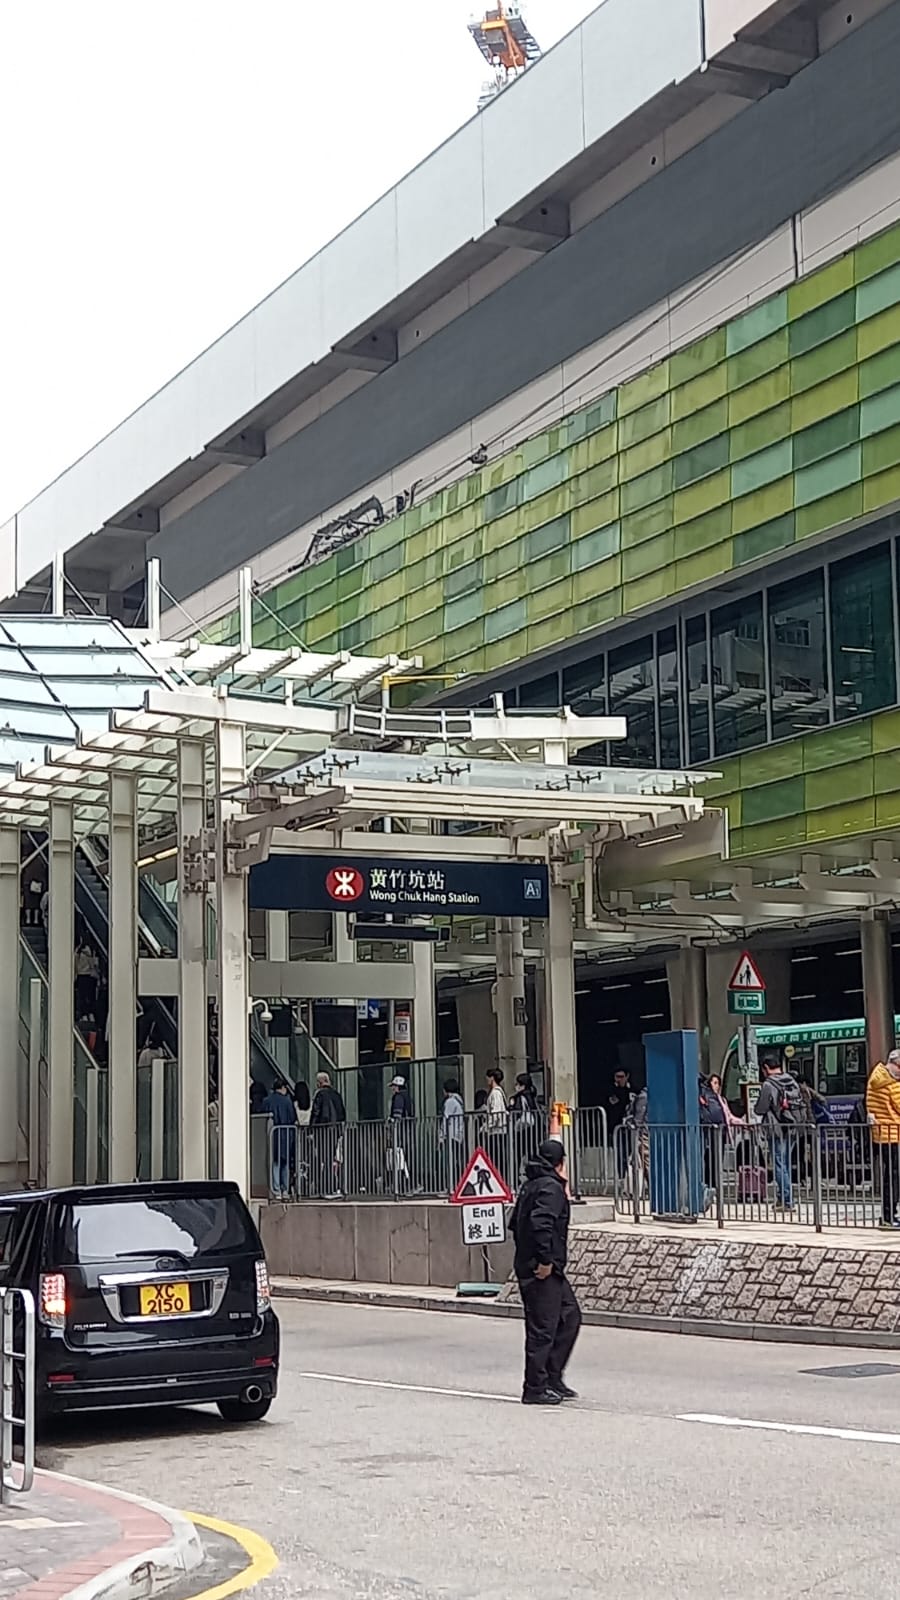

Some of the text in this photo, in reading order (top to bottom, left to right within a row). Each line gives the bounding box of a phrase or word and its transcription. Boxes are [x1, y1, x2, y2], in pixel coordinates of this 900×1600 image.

[369, 890, 480, 904] Wong Chuk Hang Station
[472, 1206, 495, 1218] End
[468, 1222, 501, 1239] 終止
[155, 1284, 175, 1299] XC
[147, 1298, 184, 1313] 2150
